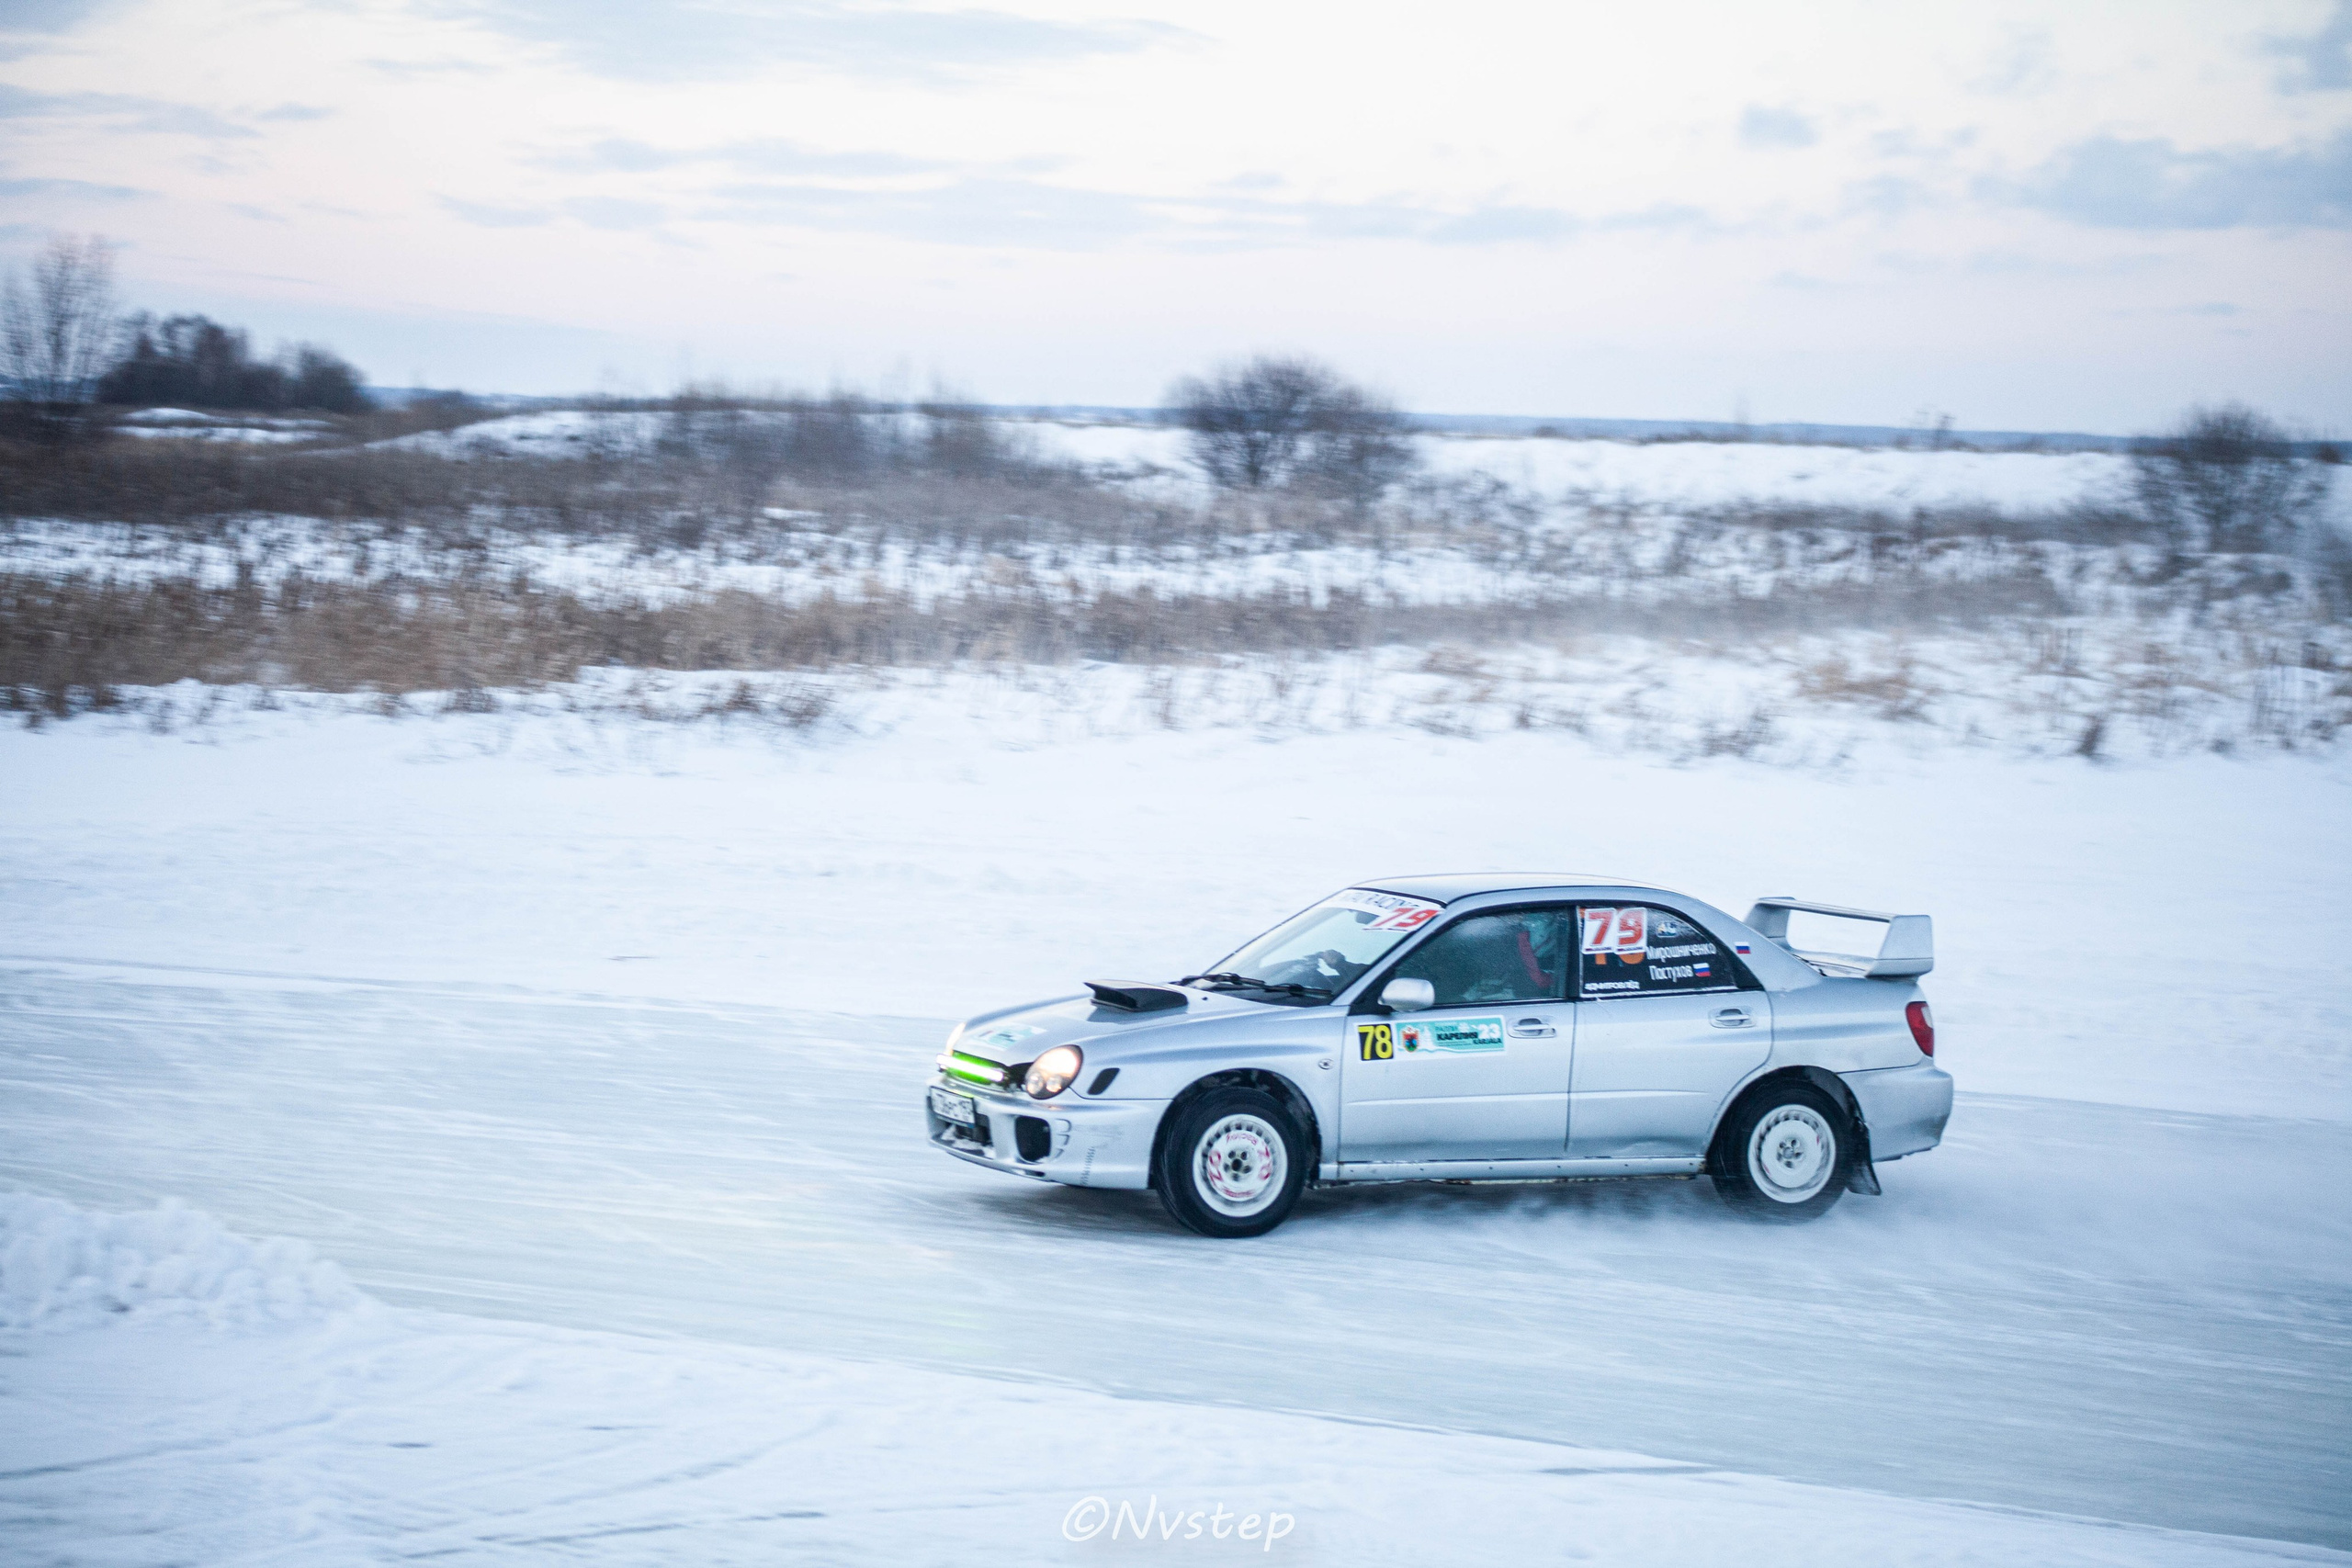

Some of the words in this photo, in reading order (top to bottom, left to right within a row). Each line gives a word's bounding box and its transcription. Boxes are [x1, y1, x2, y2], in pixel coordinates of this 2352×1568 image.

[1373, 908, 1440, 928] 79
[1588, 910, 1644, 945] 79
[1357, 1024, 1393, 1060] 78
